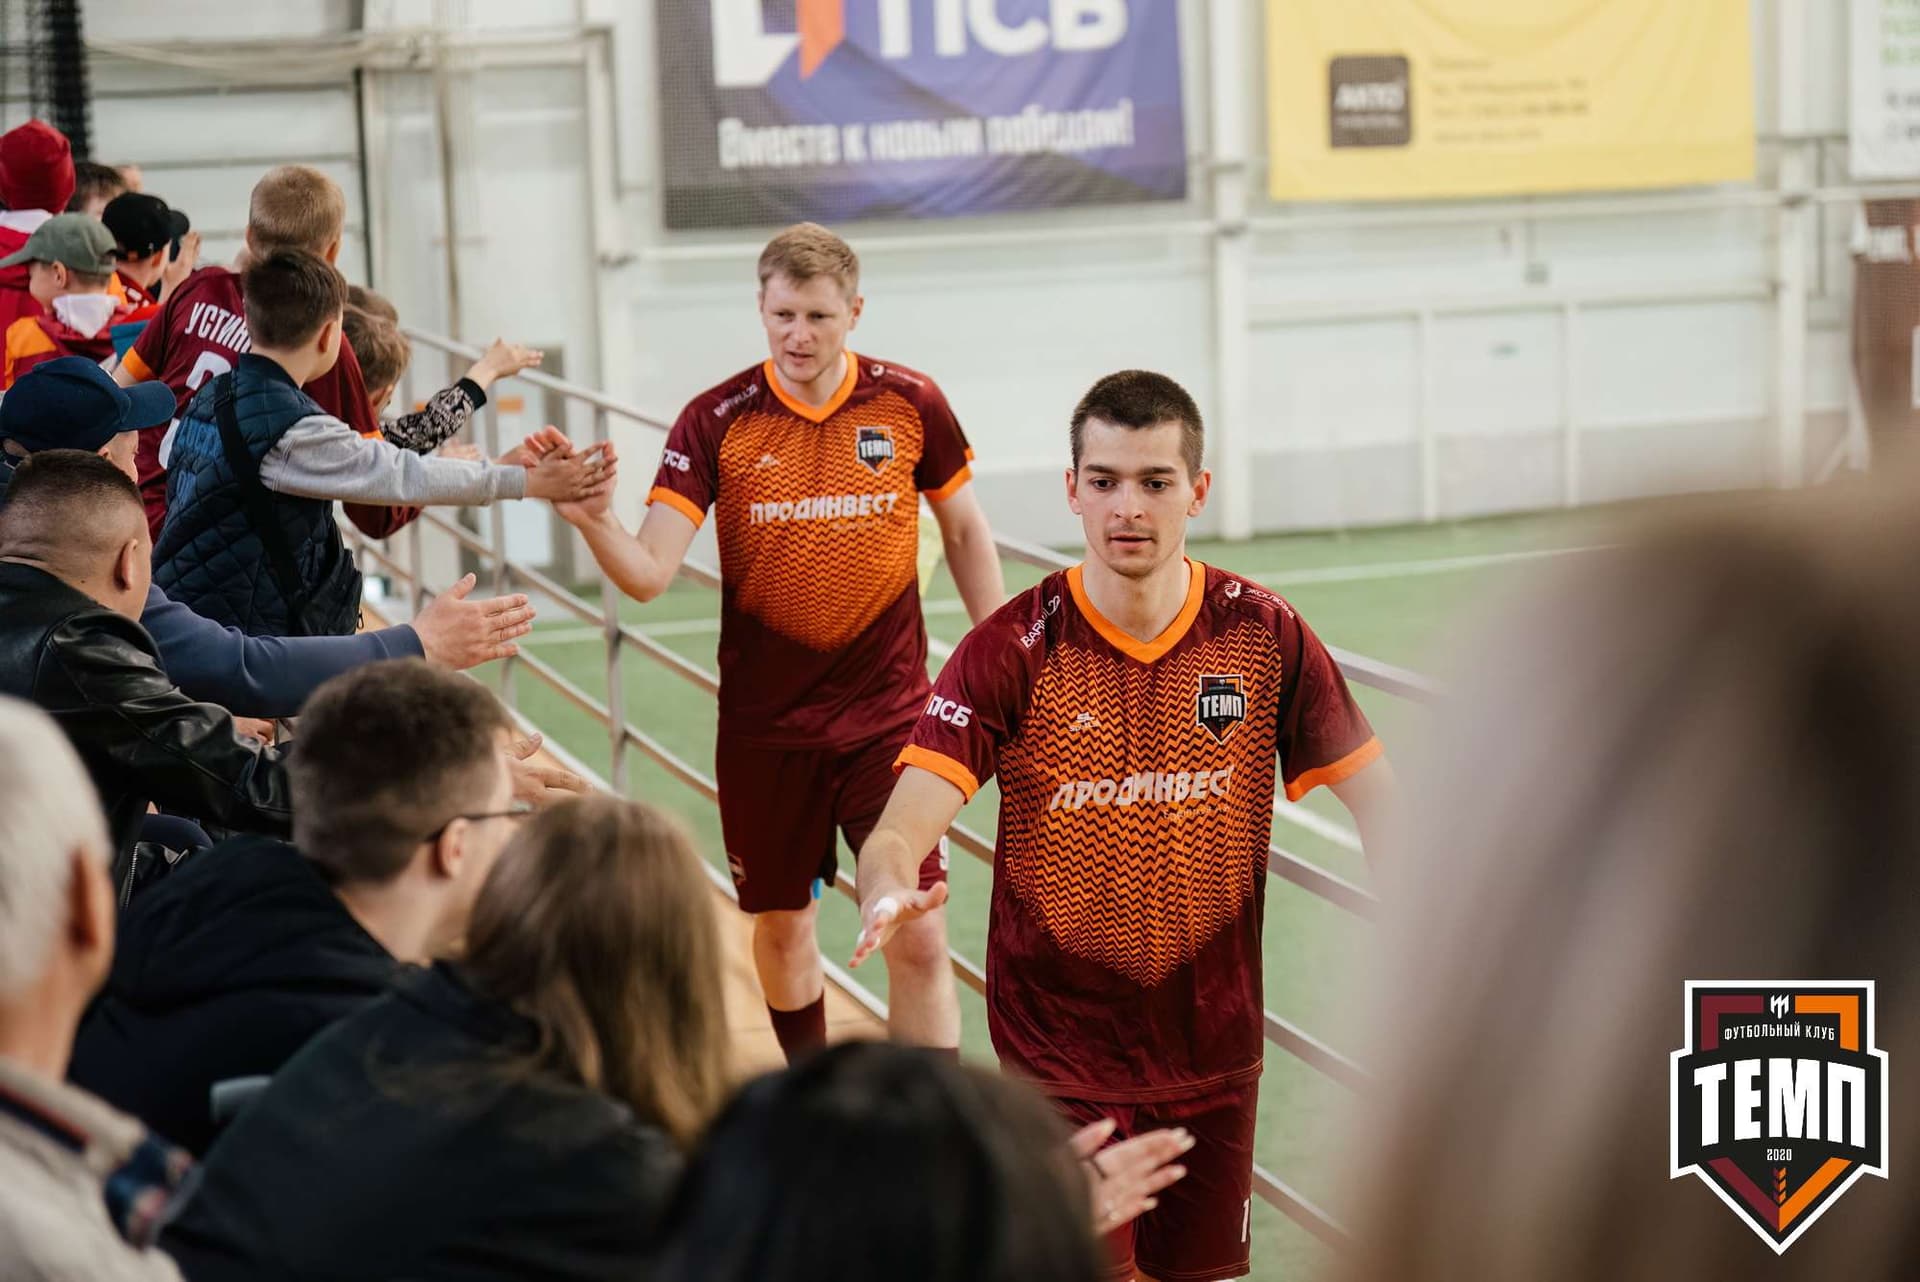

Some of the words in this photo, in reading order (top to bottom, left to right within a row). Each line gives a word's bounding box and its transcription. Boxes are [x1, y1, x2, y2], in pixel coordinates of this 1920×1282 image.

[843, 122, 867, 162] к
[869, 116, 986, 161] новым
[661, 448, 690, 472] ПСБ
[860, 439, 892, 458] ТЕМП
[750, 492, 898, 525] ПРОДИНВЕСТ
[926, 694, 973, 728] ПСБ
[1201, 694, 1242, 719] ТЕМП
